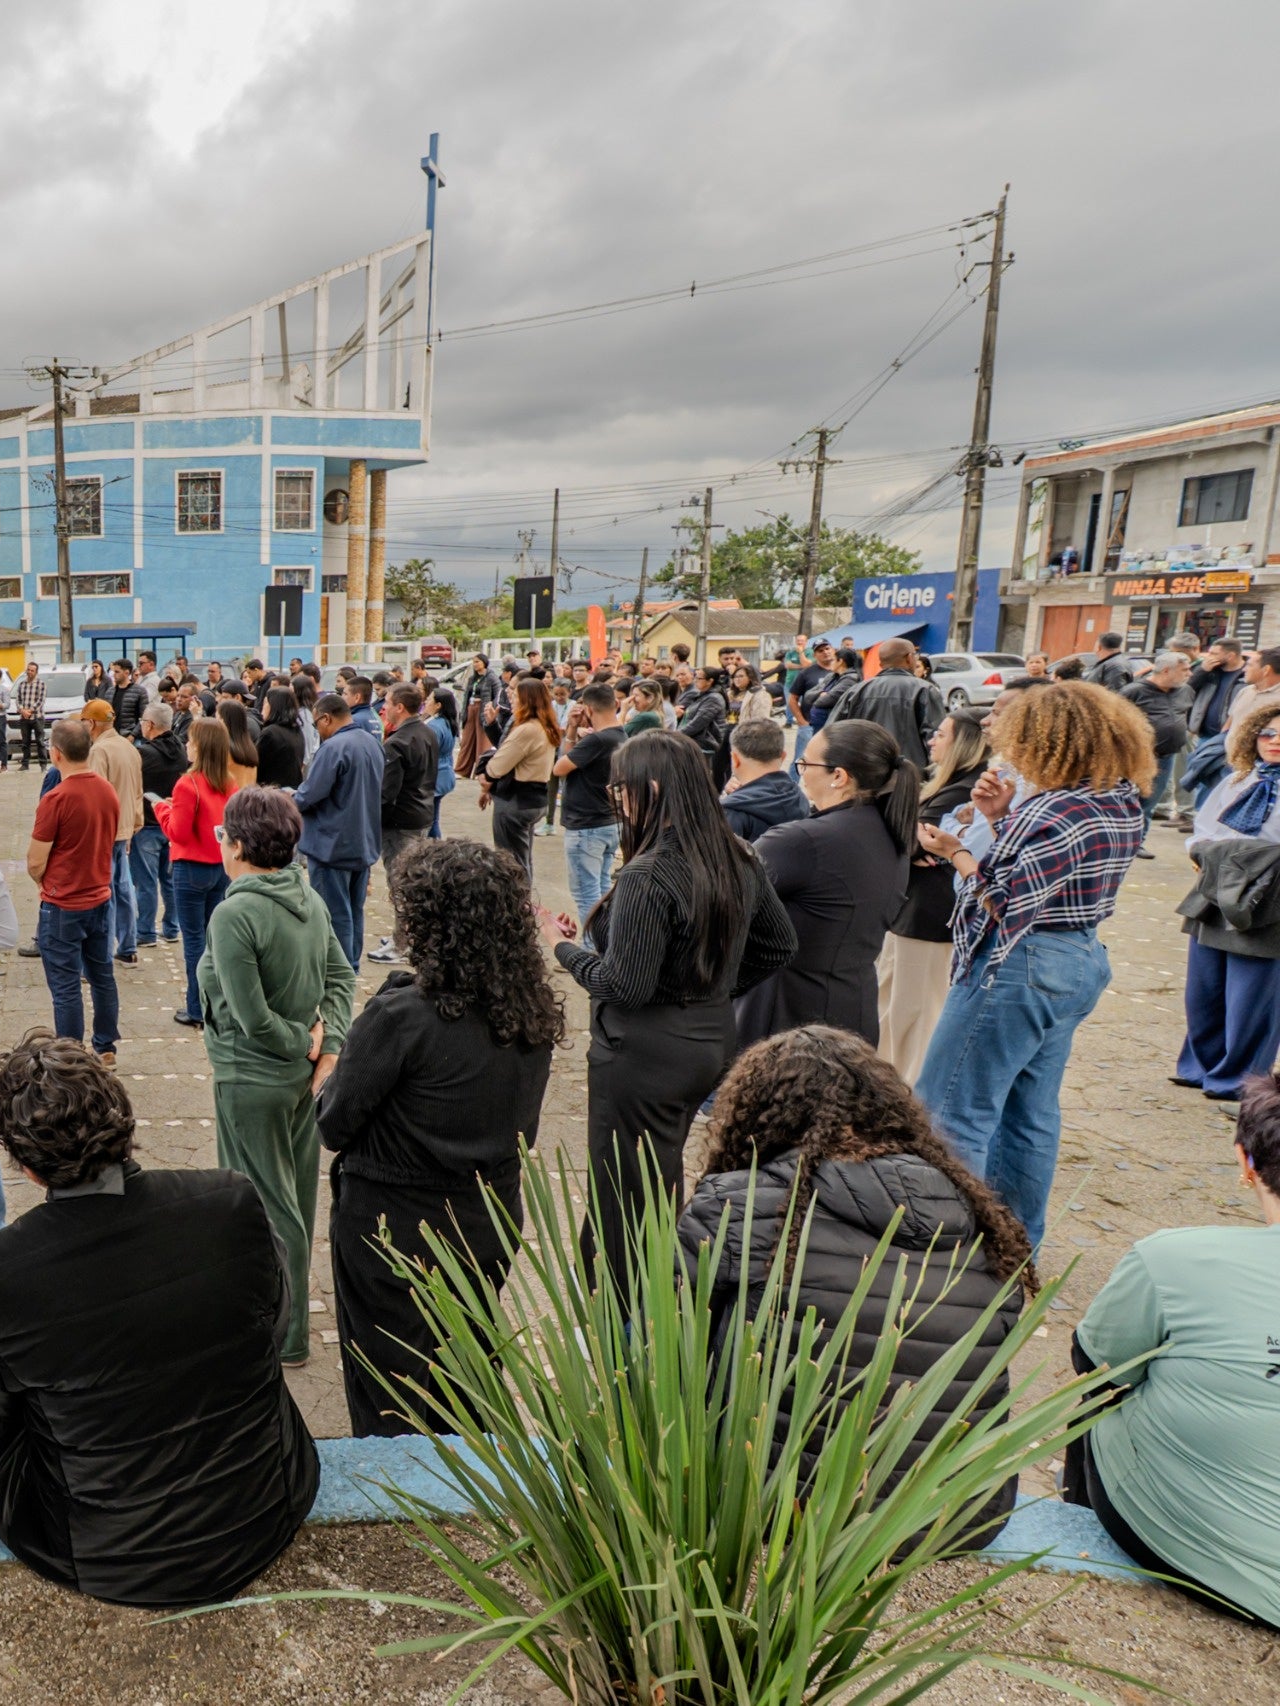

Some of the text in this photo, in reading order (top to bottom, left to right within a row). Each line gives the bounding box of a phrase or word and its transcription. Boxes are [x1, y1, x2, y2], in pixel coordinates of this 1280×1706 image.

[864, 582, 936, 609] Cirlene
[1112, 578, 1167, 596] NINJA
[1170, 576, 1206, 594] SHO
